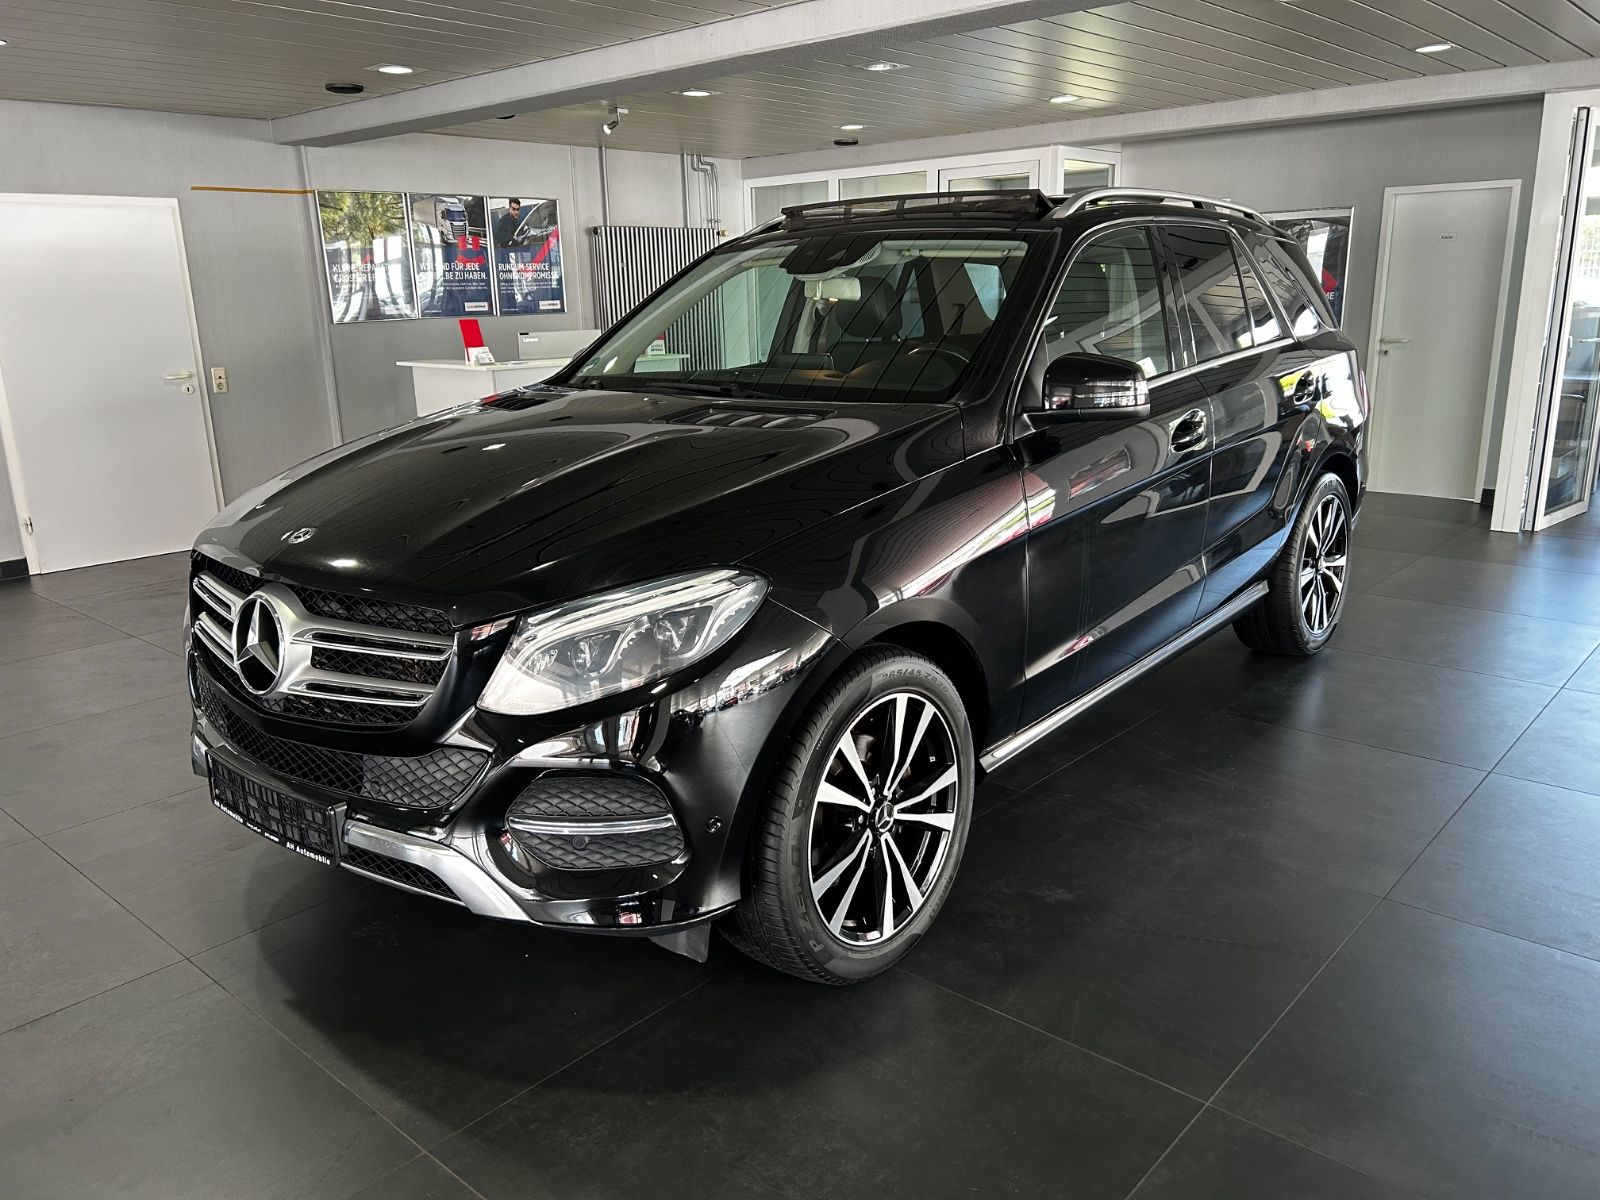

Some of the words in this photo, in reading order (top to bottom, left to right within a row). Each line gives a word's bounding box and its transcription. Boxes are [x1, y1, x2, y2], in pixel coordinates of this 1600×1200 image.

[451, 260, 464, 271] FÜR
[465, 262, 480, 271] JEDE
[454, 271, 464, 280] ZU
[464, 271, 488, 280] HABEN.
[286, 841, 295, 851] AH
[296, 845, 331, 866] Automobile
